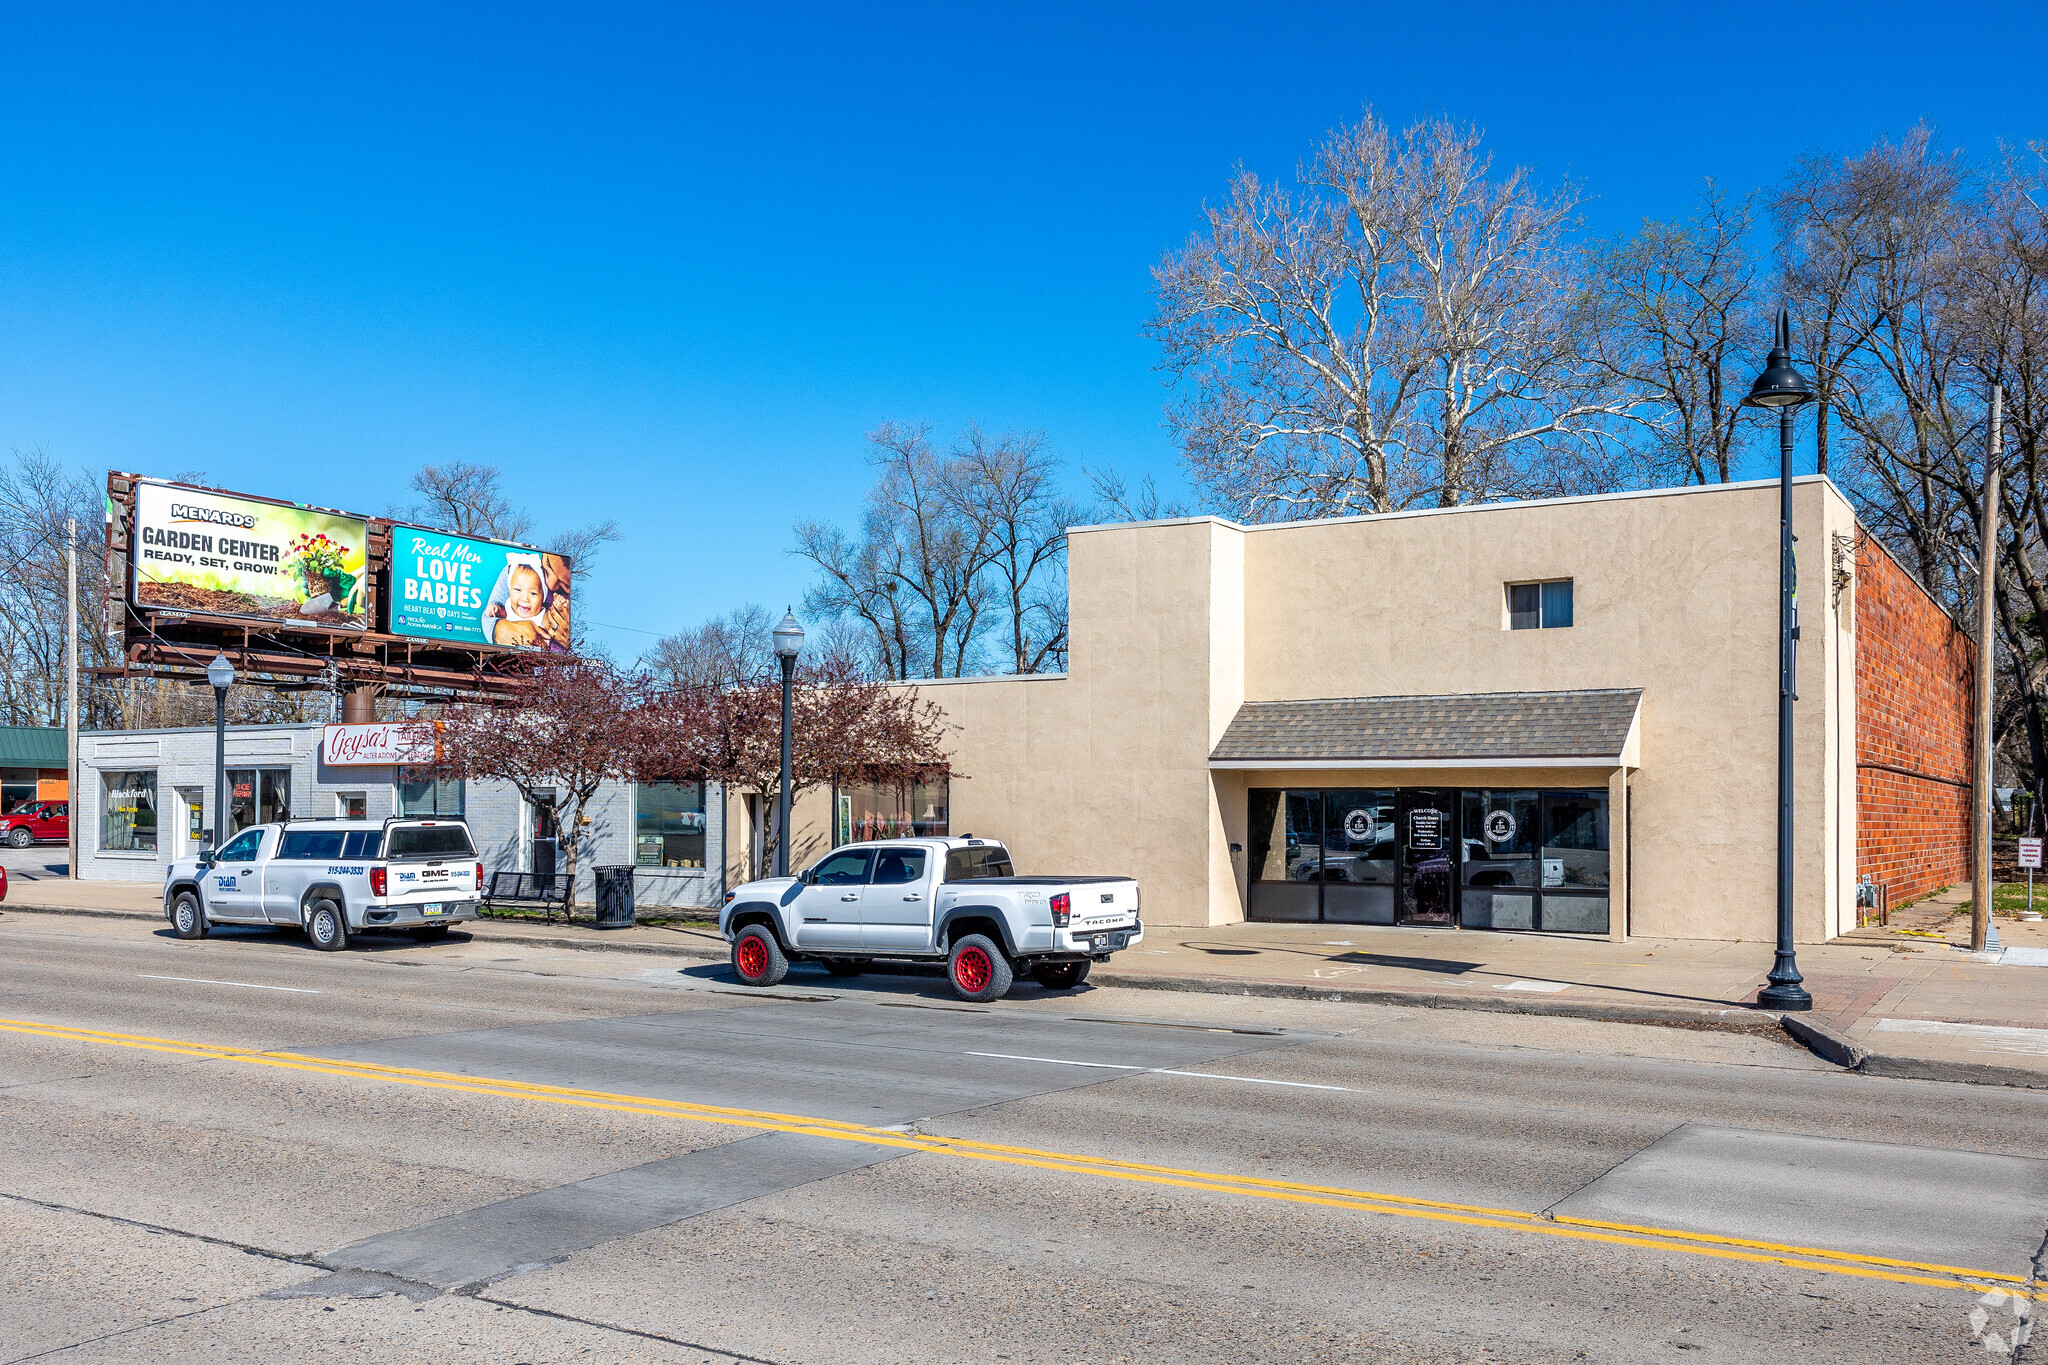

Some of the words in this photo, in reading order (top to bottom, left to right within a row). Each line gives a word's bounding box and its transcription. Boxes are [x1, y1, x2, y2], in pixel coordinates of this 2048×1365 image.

[171, 504, 255, 528] MENARDS
[142, 526, 213, 553] GARDEN
[218, 537, 280, 562] CENTER
[411, 537, 451, 559] Real
[450, 543, 483, 564] Men
[144, 549, 195, 567] READY,
[199, 556, 229, 571] SET,
[233, 561, 278, 575] GROW!
[417, 556, 472, 585] LOVE
[404, 578, 482, 609] BABIES
[404, 604, 422, 613] HEART
[422, 606, 436, 615] BEAT
[446, 610, 461, 618] DAYS
[329, 726, 390, 763] Geysa's
[363, 752, 398, 760] ALTERATIONS
[235, 783, 251, 791] SHOE
[327, 866, 364, 875] 515-244-3533
[421, 869, 449, 878] GMC
[1016, 891, 1041, 899] TRD
[1085, 917, 1124, 926] TACOMA
